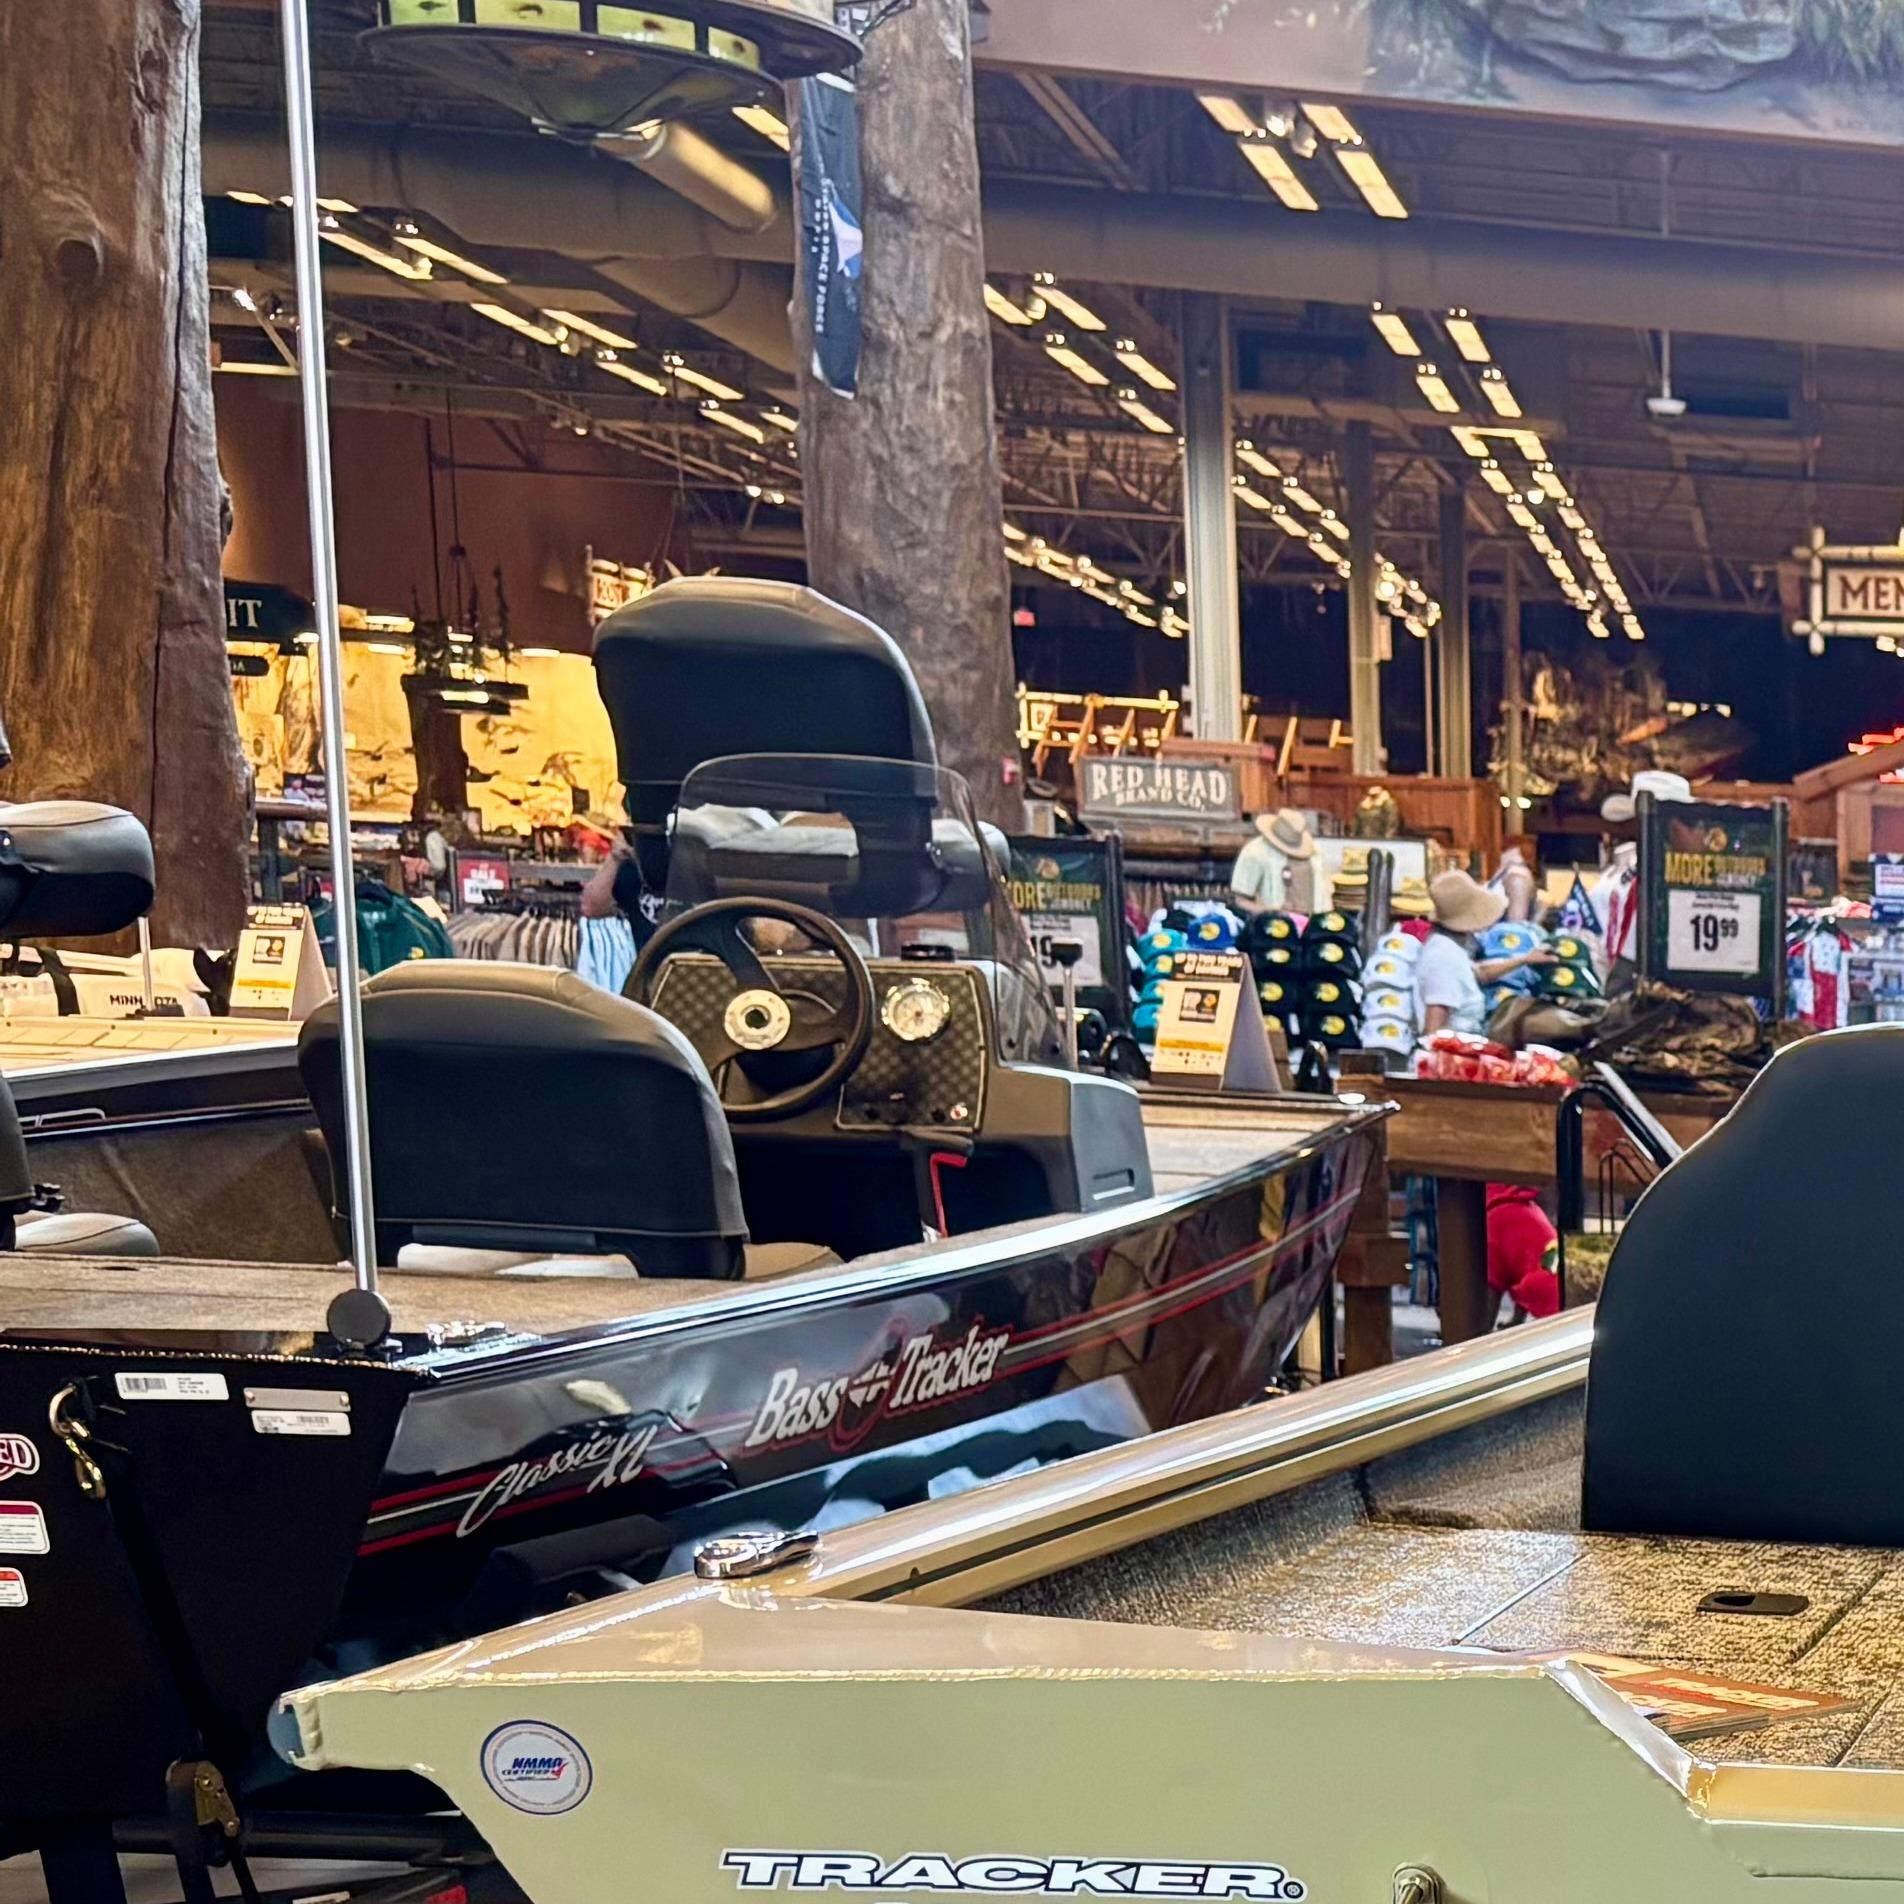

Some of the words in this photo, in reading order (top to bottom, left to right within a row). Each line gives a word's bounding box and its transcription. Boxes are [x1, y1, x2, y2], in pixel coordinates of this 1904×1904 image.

[1092, 763, 1144, 800] RED
[1155, 767, 1227, 805] HEAD
[1665, 851, 1714, 885] MORE
[744, 1366, 848, 1448] Bass
[888, 1326, 1009, 1410] Tracker
[456, 1429, 612, 1539] Classic
